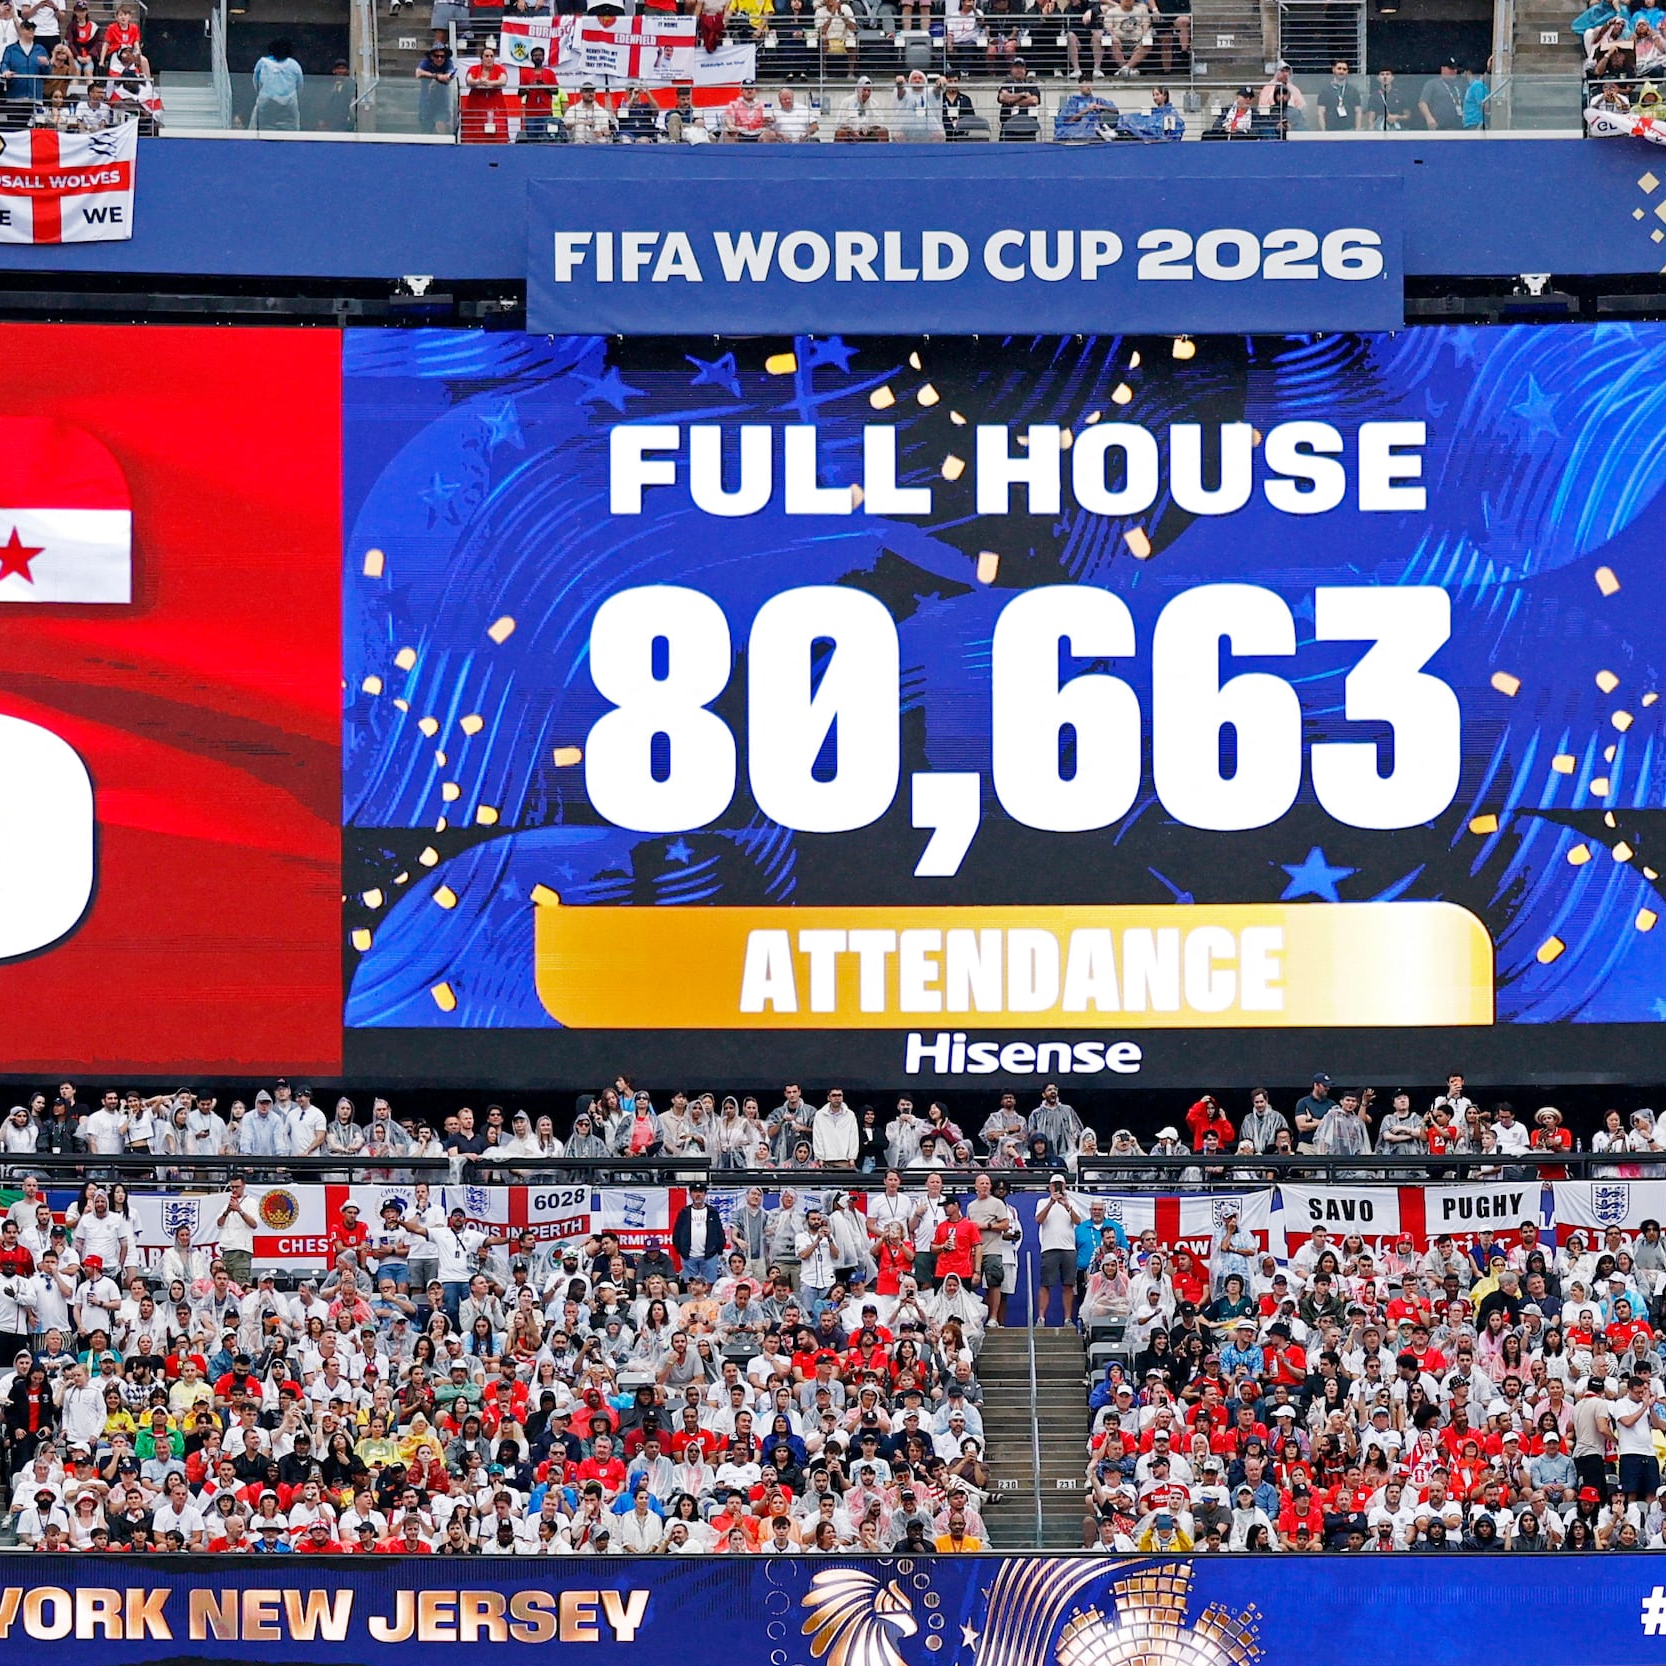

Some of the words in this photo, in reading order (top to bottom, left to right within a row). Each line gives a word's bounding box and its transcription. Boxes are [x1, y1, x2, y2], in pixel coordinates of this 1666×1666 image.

[614, 33, 658, 46] EDENFIELD
[49, 170, 120, 188] WOLVES
[83, 206, 123, 224] WE
[554, 231, 702, 283] FIFA
[713, 230, 970, 283] WORLD
[983, 230, 1123, 281] CUP
[1137, 229, 1382, 280] 2026
[609, 422, 932, 516] FULL
[976, 420, 1429, 514] HOUSE
[584, 583, 1463, 878] 80,663
[738, 926, 1284, 1015] ATTENDANCE
[904, 1031, 1143, 1076] Hisense
[534, 1188, 584, 1211] 6028
[1309, 1198, 1374, 1222] SAVO
[1442, 1192, 1524, 1220] PUGHY
[531, 1218, 583, 1242] PERTH
[999, 1480, 1017, 1489] 230
[1058, 1480, 1077, 1489] 231
[188, 1587, 353, 1642] NEW
[366, 1587, 651, 1644] JERSEY
